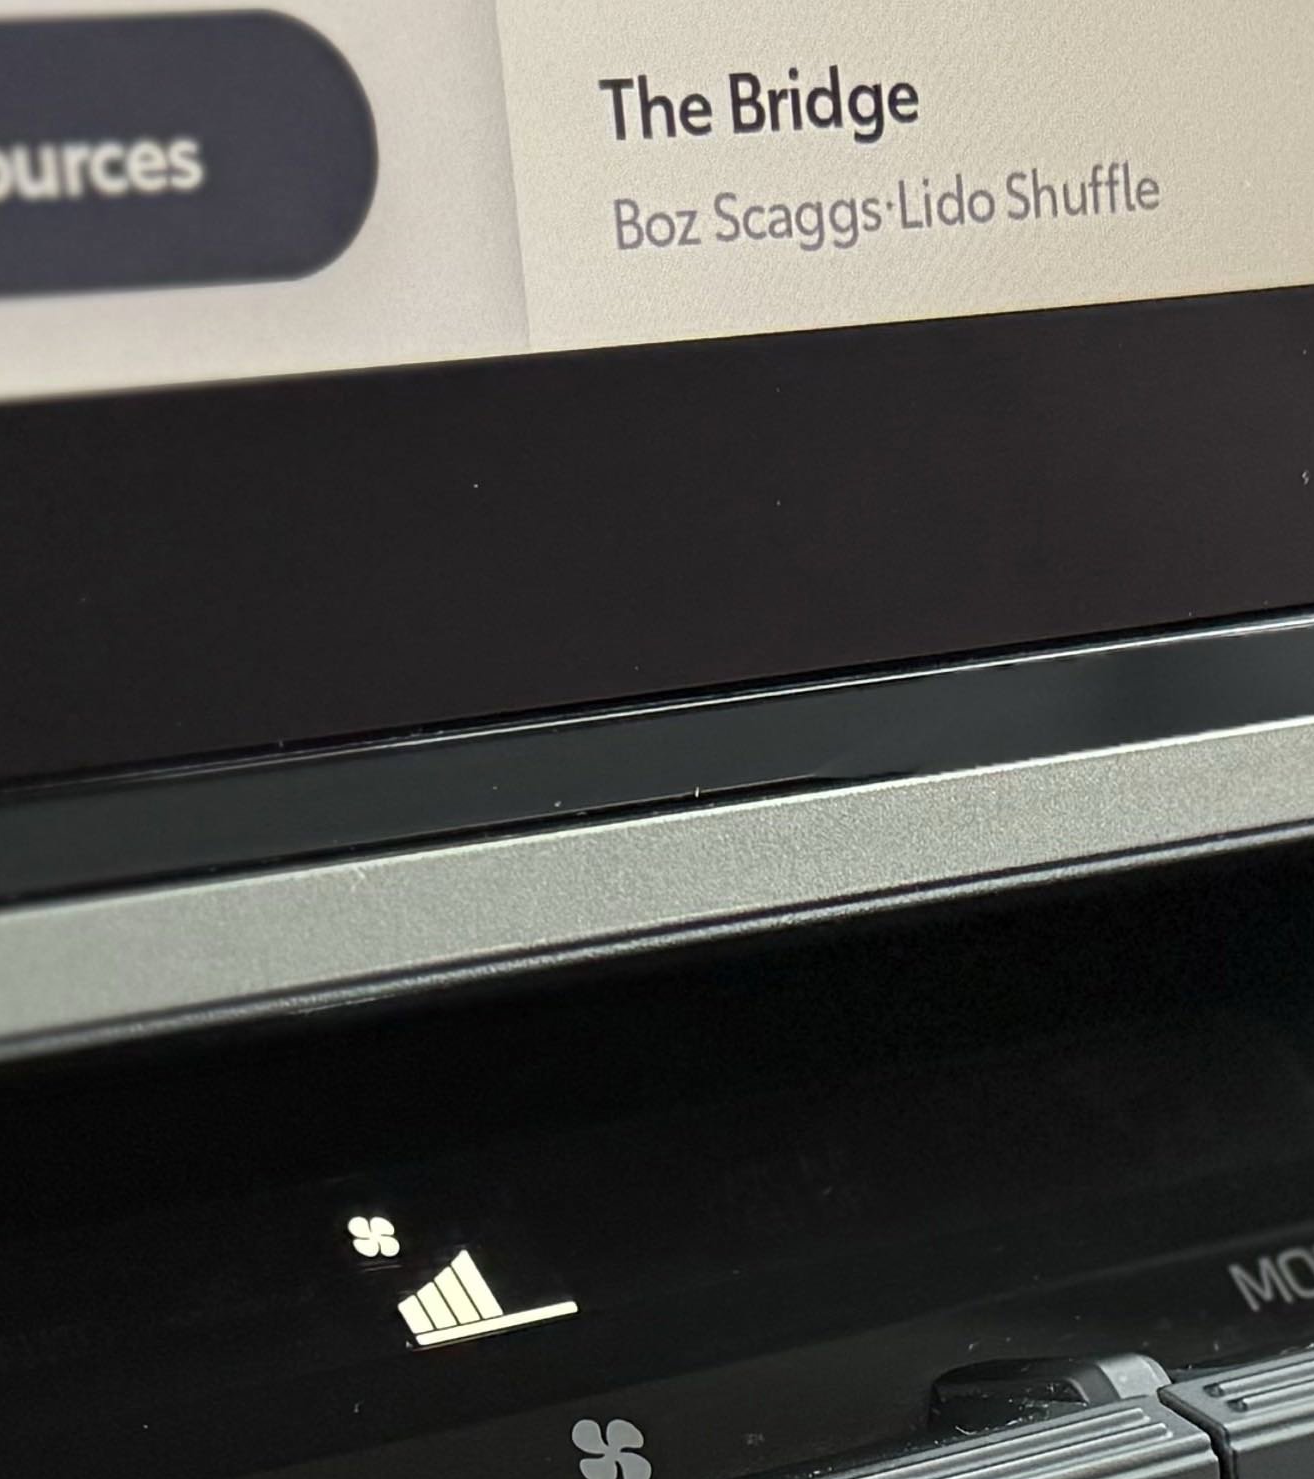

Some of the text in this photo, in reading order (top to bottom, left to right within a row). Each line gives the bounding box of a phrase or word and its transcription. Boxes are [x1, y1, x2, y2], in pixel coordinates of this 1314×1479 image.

[599, 65, 920, 144] The Bridge
[615, 198, 701, 250] Boz
[1006, 161, 1161, 222] Shuffle
